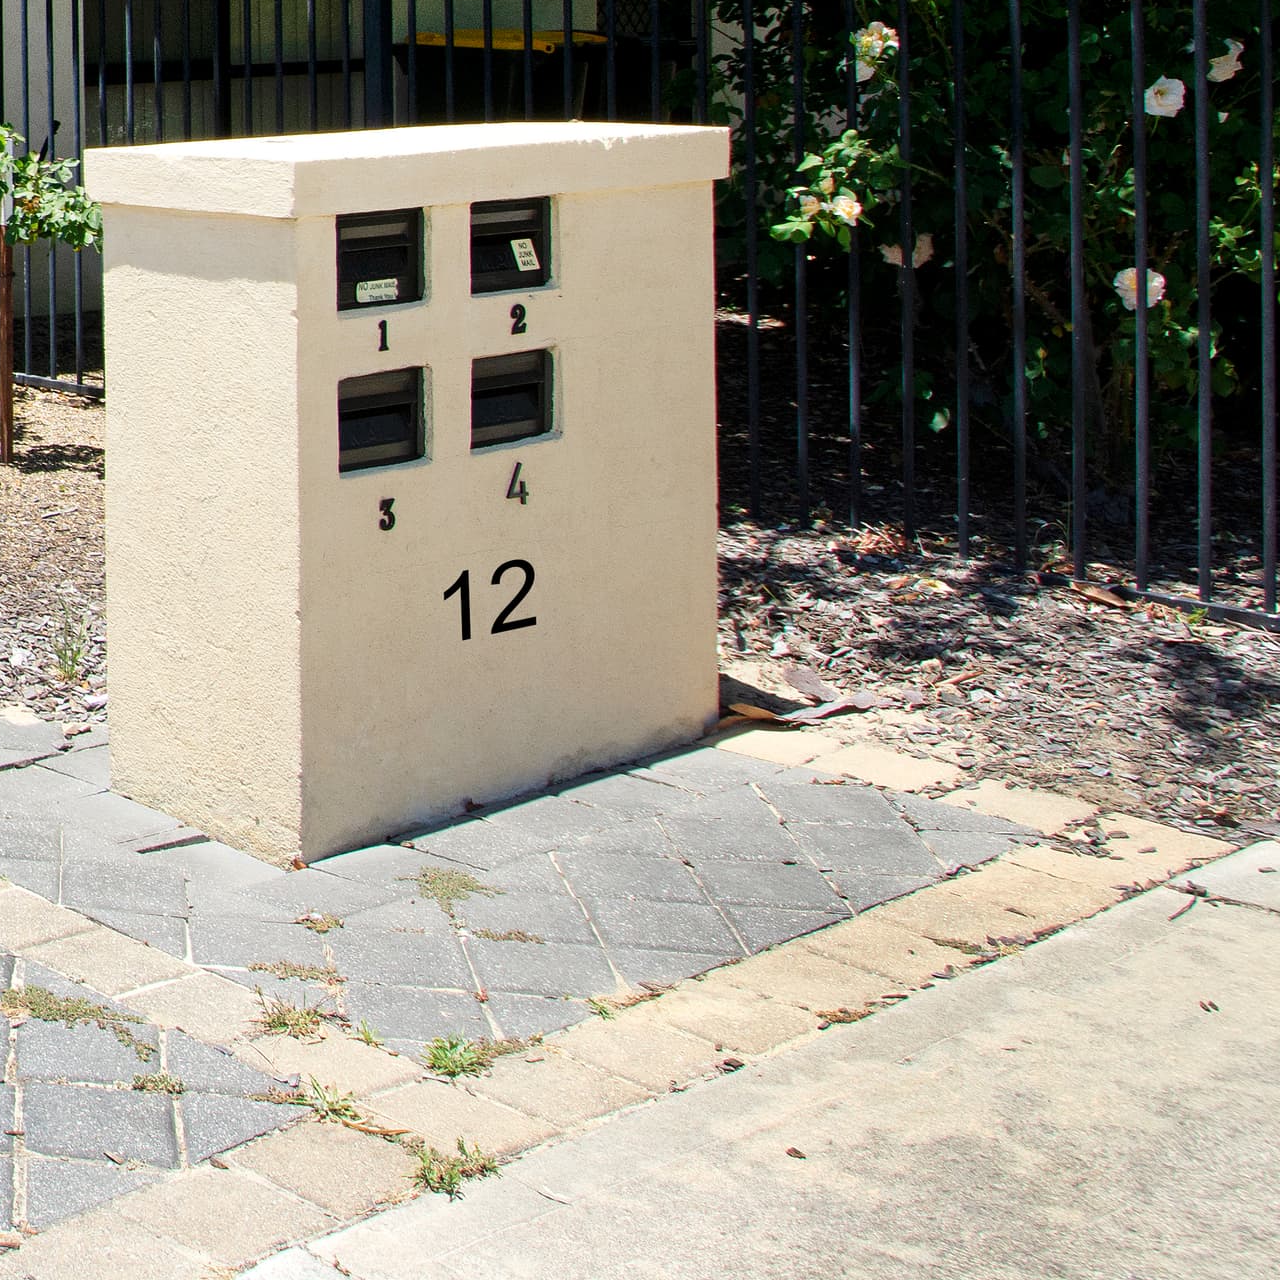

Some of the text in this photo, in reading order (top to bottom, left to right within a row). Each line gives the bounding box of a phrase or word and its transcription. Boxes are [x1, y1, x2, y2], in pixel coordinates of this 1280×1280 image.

[517, 241, 528, 250] NO
[517, 250, 534, 259] JUNK
[521, 258, 536, 267] MAIL
[359, 282, 369, 291] NO
[369, 282, 383, 290] JUNK
[378, 319, 390, 352] 1
[509, 303, 527, 336] 2
[505, 461, 530, 506] 4
[378, 497, 397, 532] 3
[443, 558, 537, 641] 12
